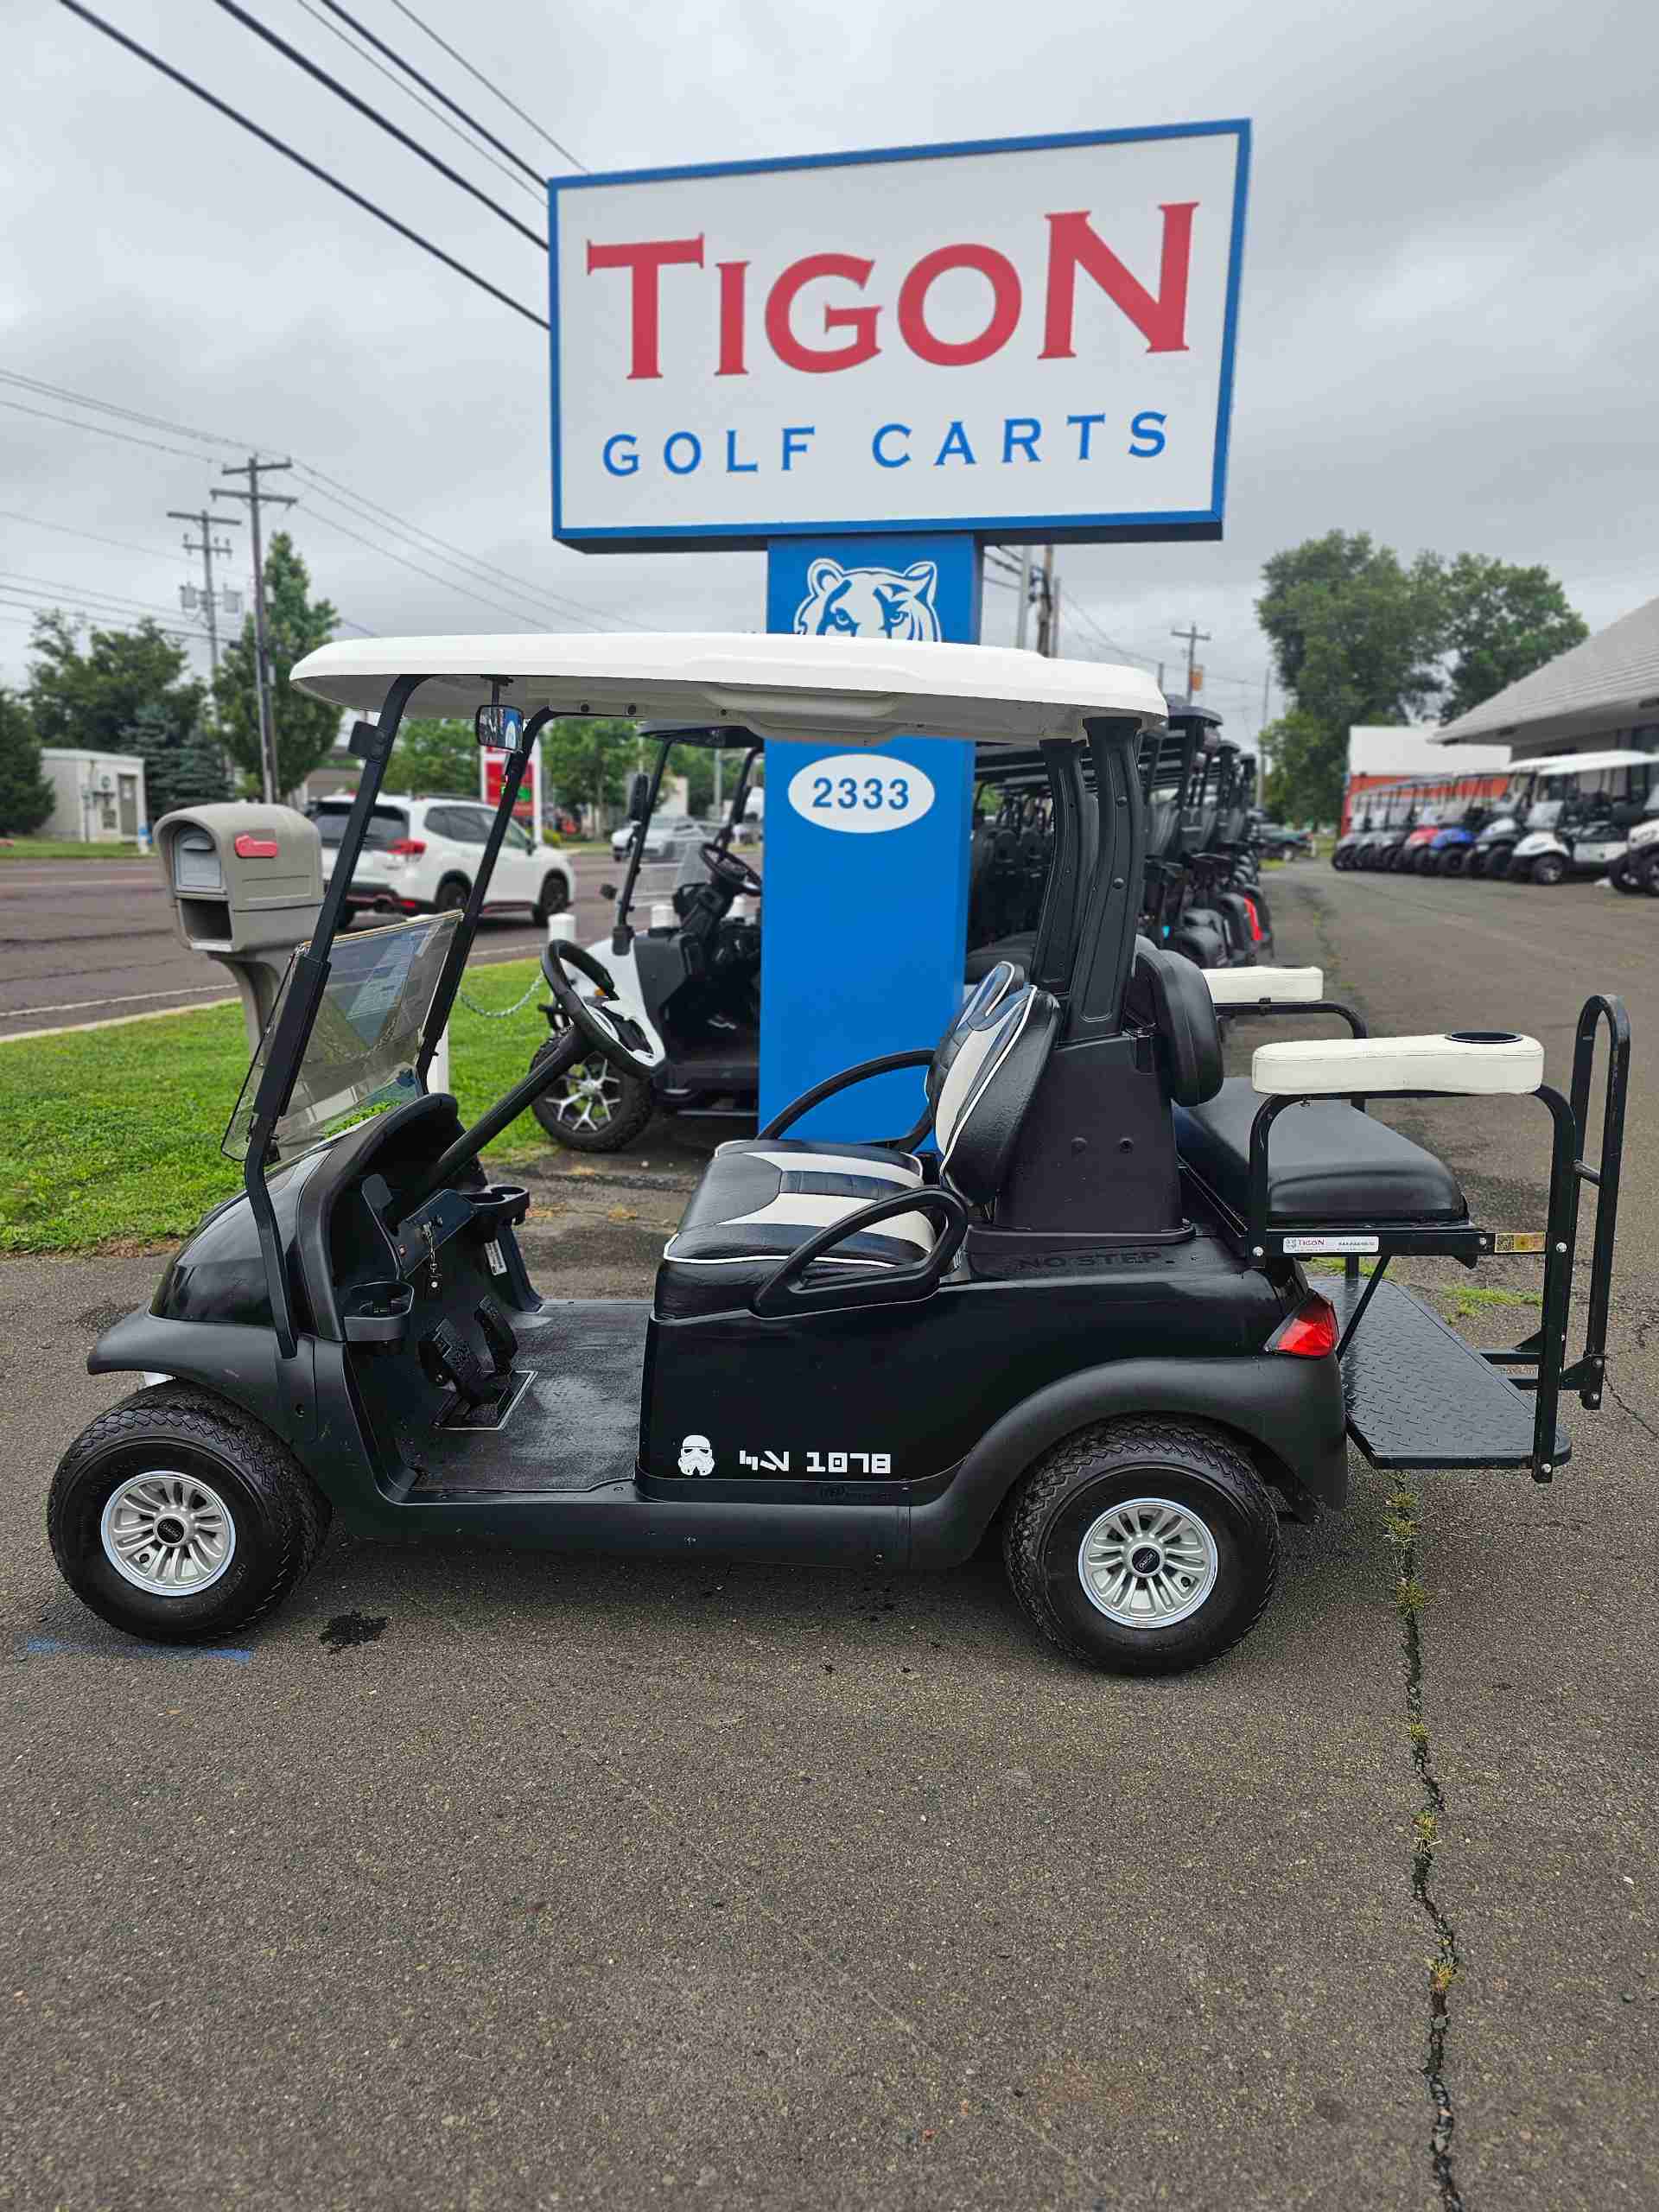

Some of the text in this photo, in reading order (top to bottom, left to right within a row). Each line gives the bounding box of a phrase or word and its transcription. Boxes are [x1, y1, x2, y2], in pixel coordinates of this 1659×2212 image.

[587, 201, 1198, 380] TIGON
[602, 410, 1167, 477] GOLF CARTS
[812, 776, 910, 810] 2333
[806, 1452, 891, 1474] 1078
